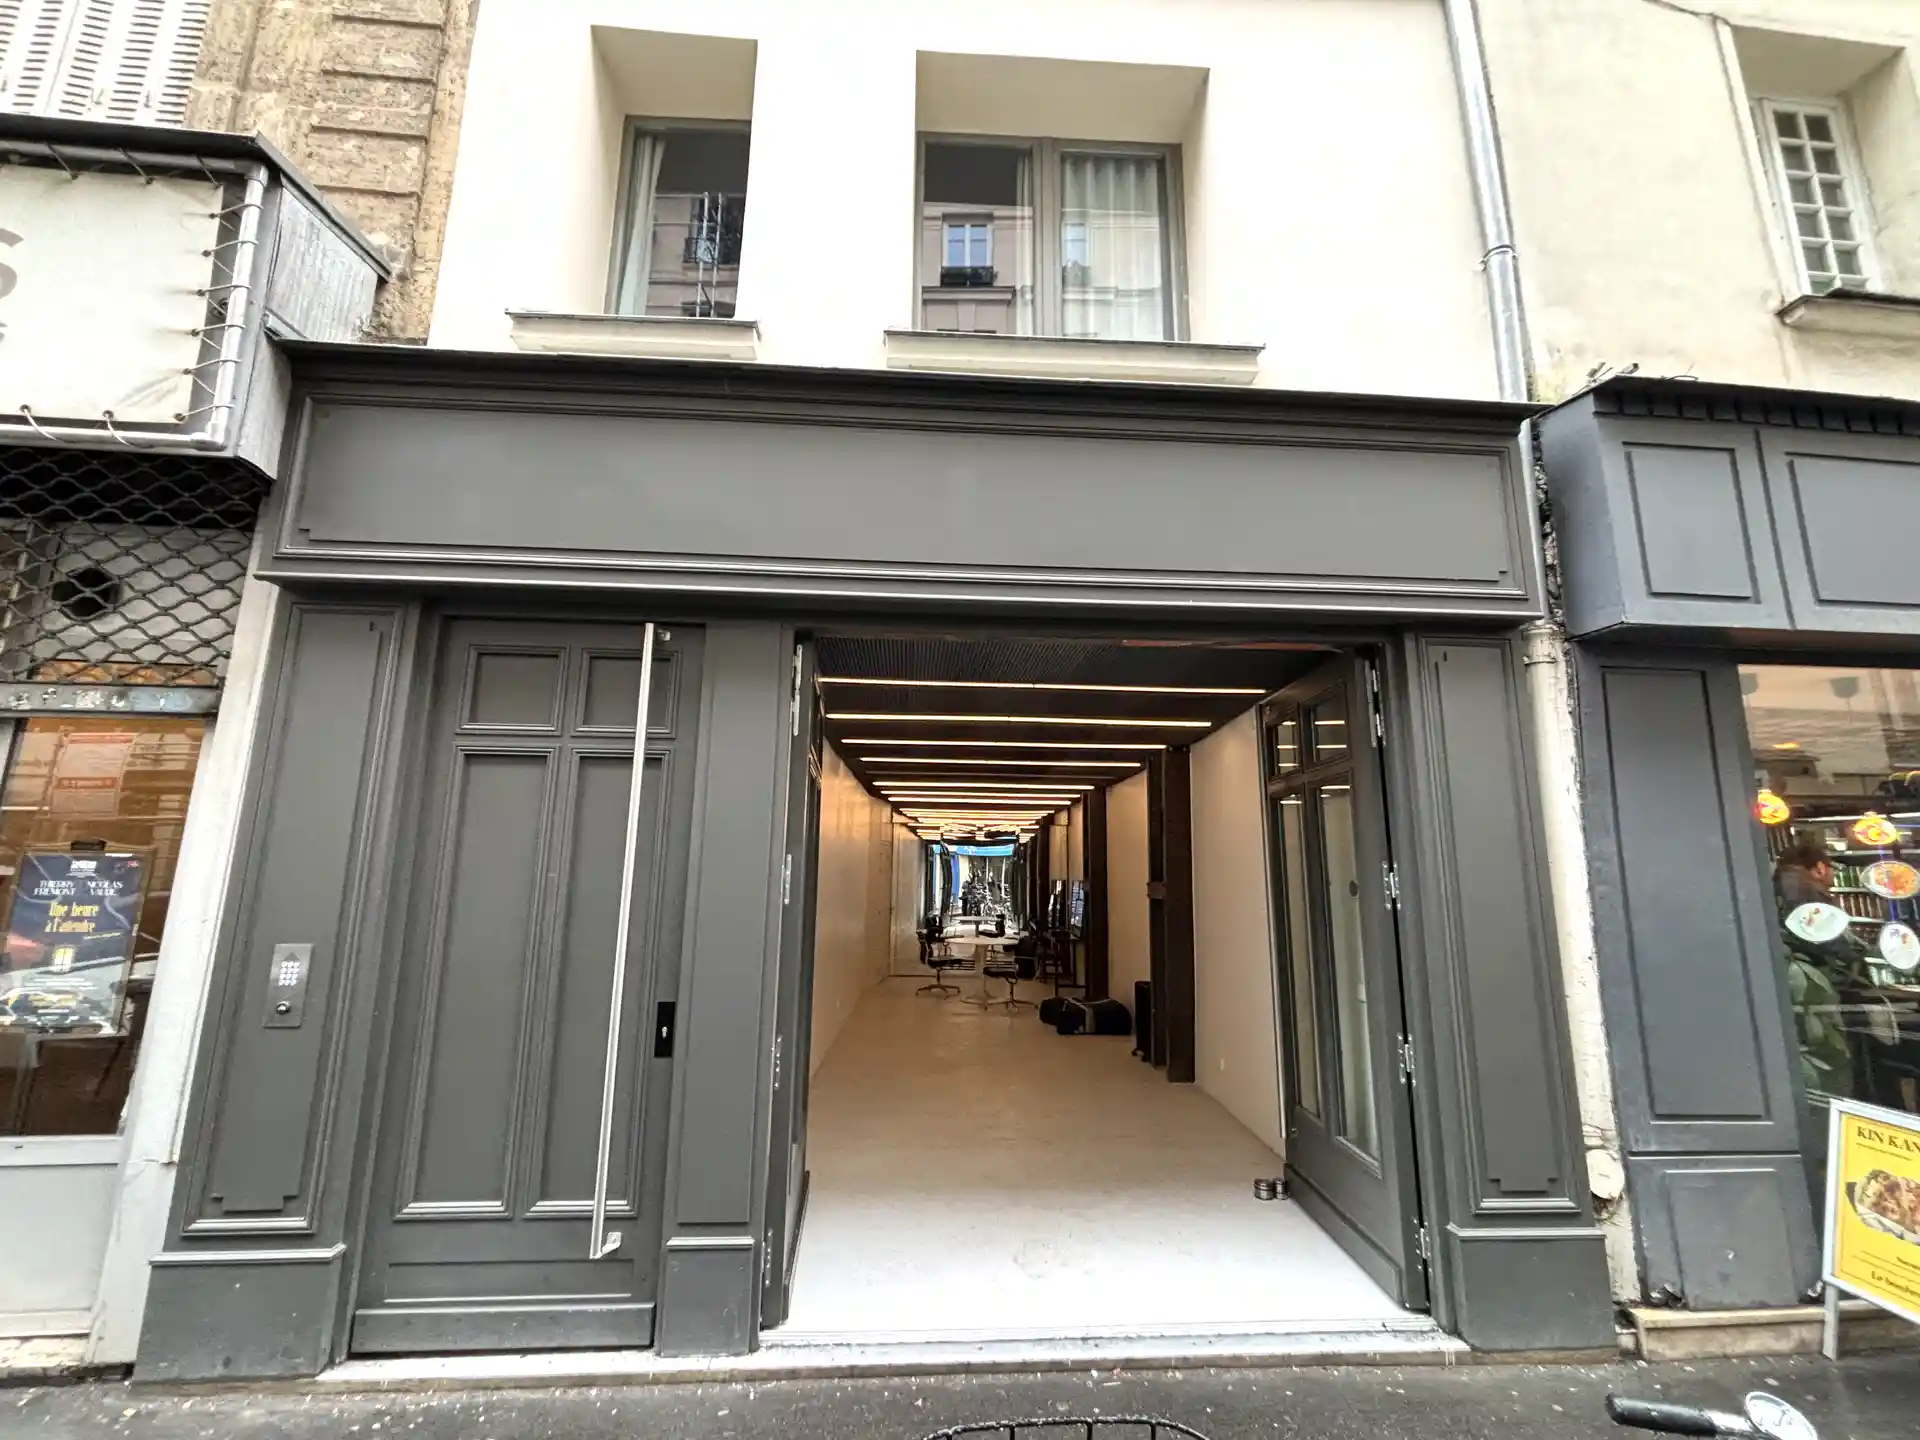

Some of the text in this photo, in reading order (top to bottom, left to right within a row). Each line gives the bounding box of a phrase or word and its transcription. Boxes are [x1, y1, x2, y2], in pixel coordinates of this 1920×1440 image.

[48, 901, 100, 917] Une heure
[1856, 1126, 1884, 1144] KIN
